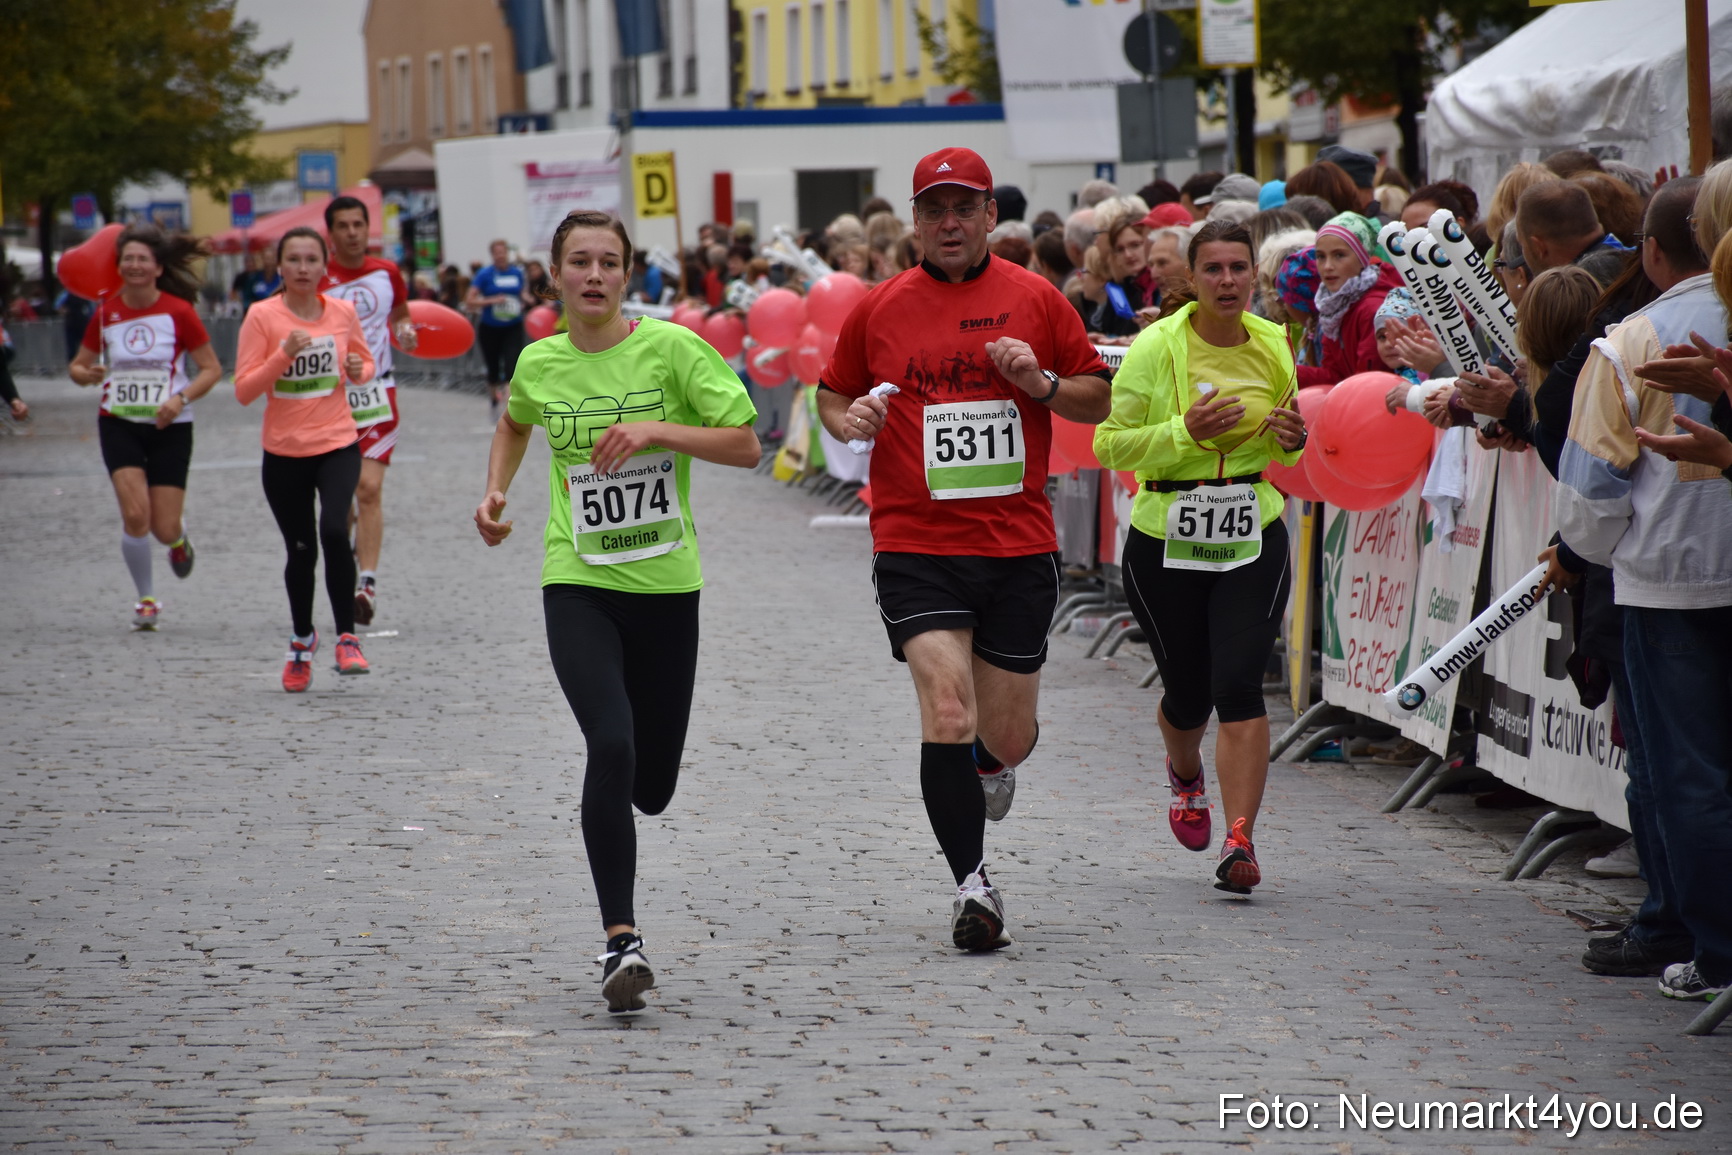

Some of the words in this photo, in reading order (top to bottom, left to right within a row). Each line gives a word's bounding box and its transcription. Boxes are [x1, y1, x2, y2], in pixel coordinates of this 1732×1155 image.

[645, 172, 668, 205] D
[1425, 273, 1460, 321] BMW
[959, 317, 995, 330] swn
[1101, 350, 1125, 367] bm
[116, 383, 164, 403] 5017
[347, 386, 381, 409] 051
[926, 412, 960, 424] PARTL
[961, 409, 1007, 421] Neumarkt
[935, 422, 1015, 463] 5311
[570, 474, 604, 486] PARTL
[605, 465, 658, 481] Neumarkt
[581, 477, 670, 527] 5074
[1178, 493, 1205, 503] ARTL
[1206, 493, 1247, 504] Neumarkt
[1177, 505, 1254, 539] 5145
[601, 529, 659, 551] Caterina
[1191, 545, 1236, 560] Monika
